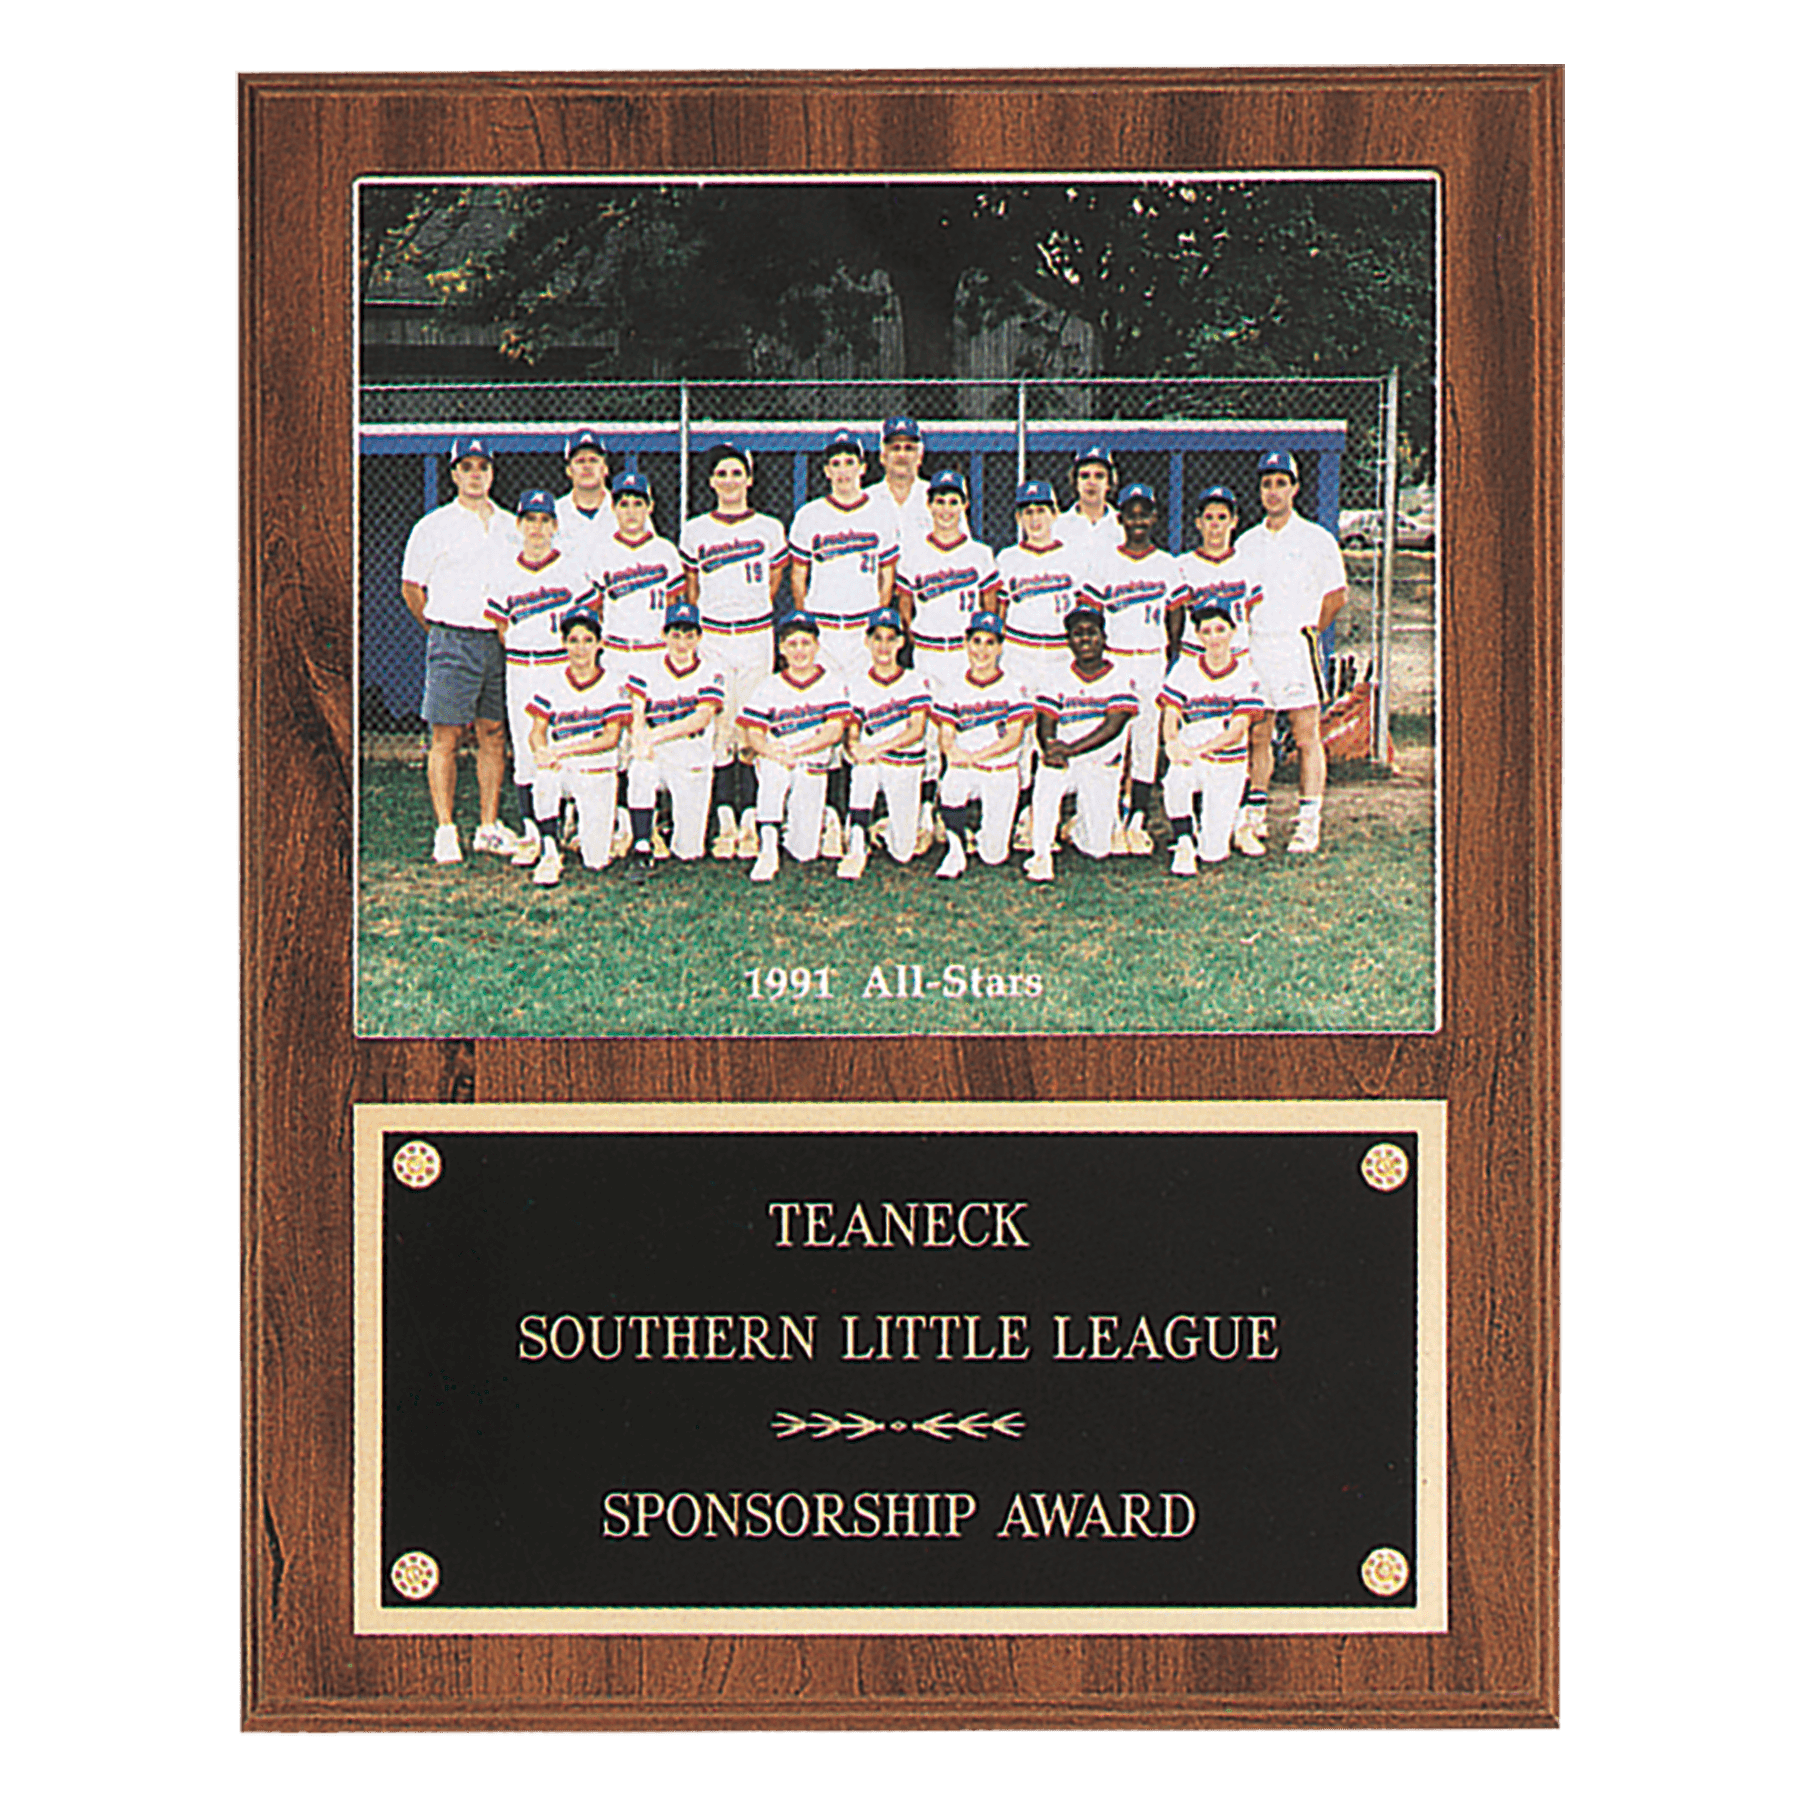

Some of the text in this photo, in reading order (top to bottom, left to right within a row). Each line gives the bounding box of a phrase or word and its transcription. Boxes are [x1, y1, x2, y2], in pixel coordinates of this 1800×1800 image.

[744, 963, 1044, 1001] 1991 All-Stars
[768, 1201, 1031, 1248] TEANECK
[518, 1314, 1280, 1361] SOUTHERN LITTLE LEAGUE
[602, 1491, 1197, 1539] SPONSORSHIP AWARD
